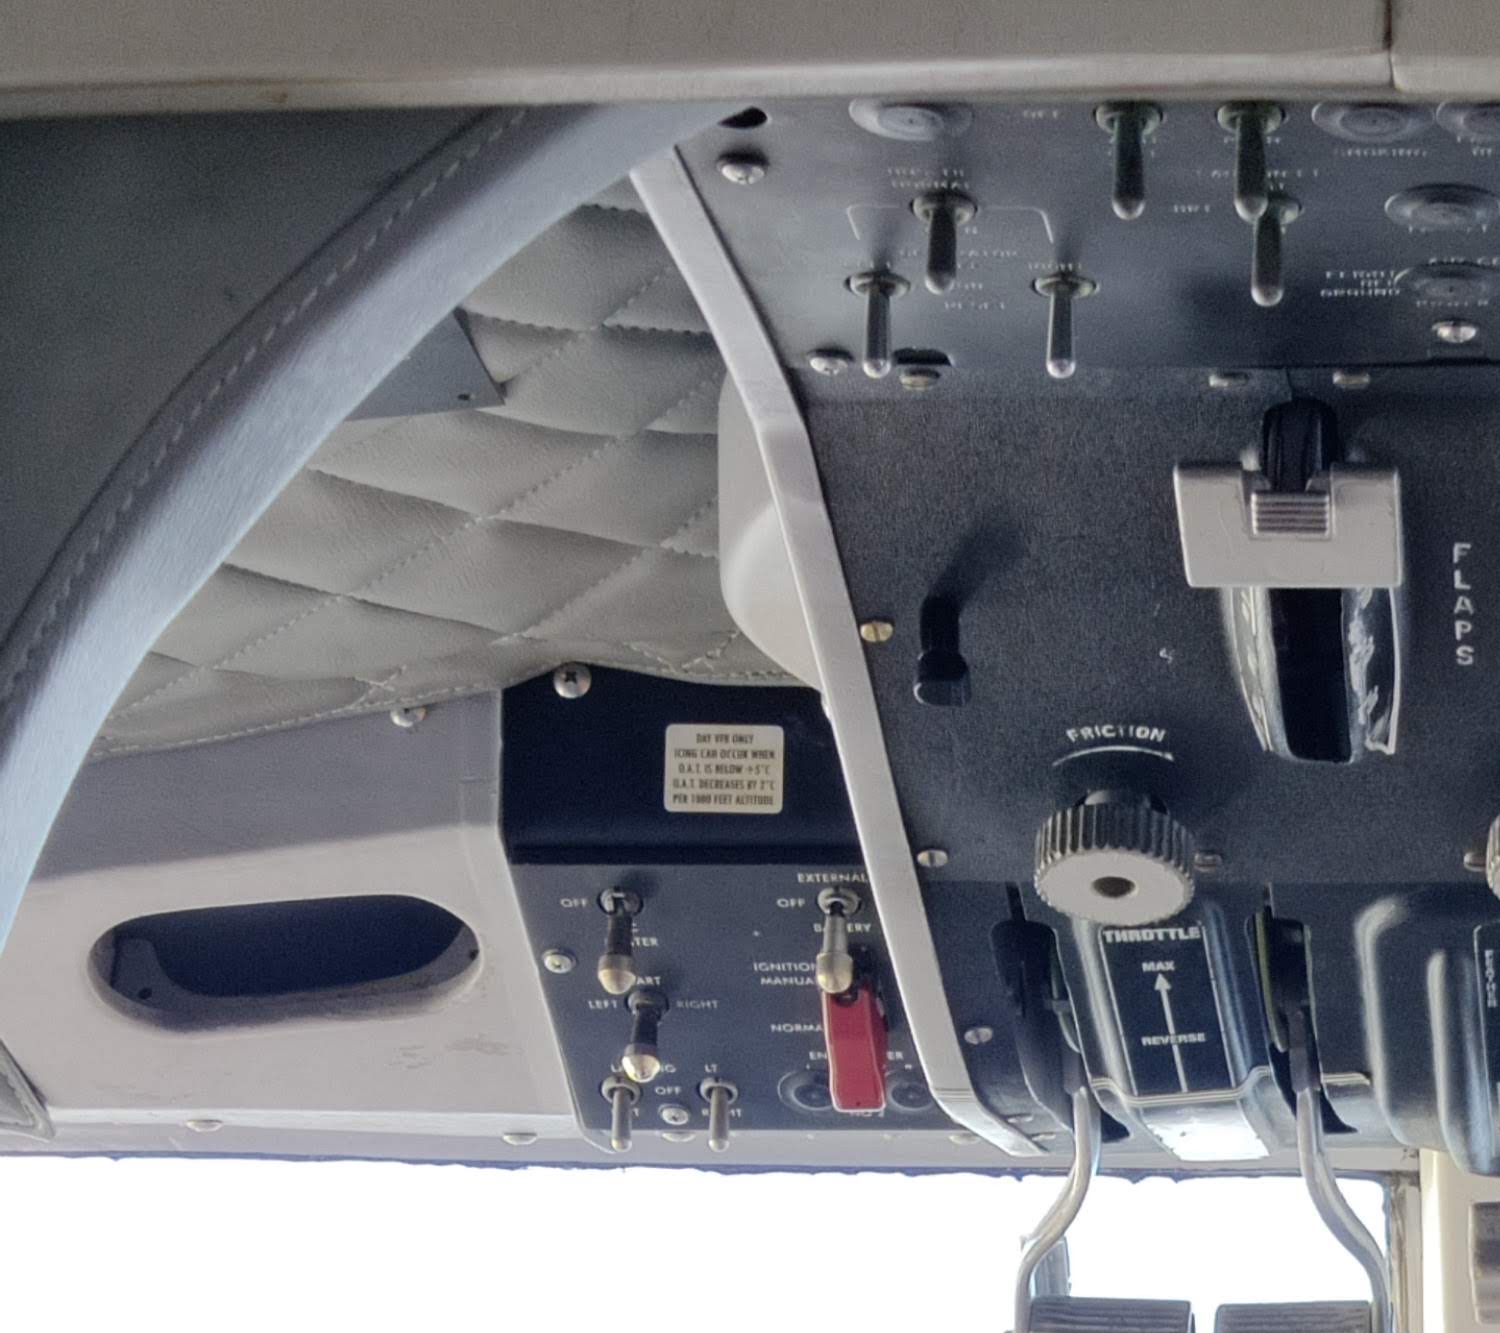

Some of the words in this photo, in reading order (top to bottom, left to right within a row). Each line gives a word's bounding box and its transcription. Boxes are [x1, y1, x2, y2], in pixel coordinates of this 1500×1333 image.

[1451, 541, 1475, 668] FLAPS
[1064, 722, 1167, 746] FRICTION
[797, 872, 868, 883] EXTERNAL
[560, 898, 588, 908] OFF
[776, 898, 806, 908] OFF
[1102, 926, 1201, 943] THROTTLE
[1141, 960, 1175, 972] MAX
[588, 999, 619, 1010] LEFT
[676, 999, 719, 1010] RIGHT
[1140, 1032, 1207, 1046] REVERSE
[655, 1085, 682, 1096] OFF
